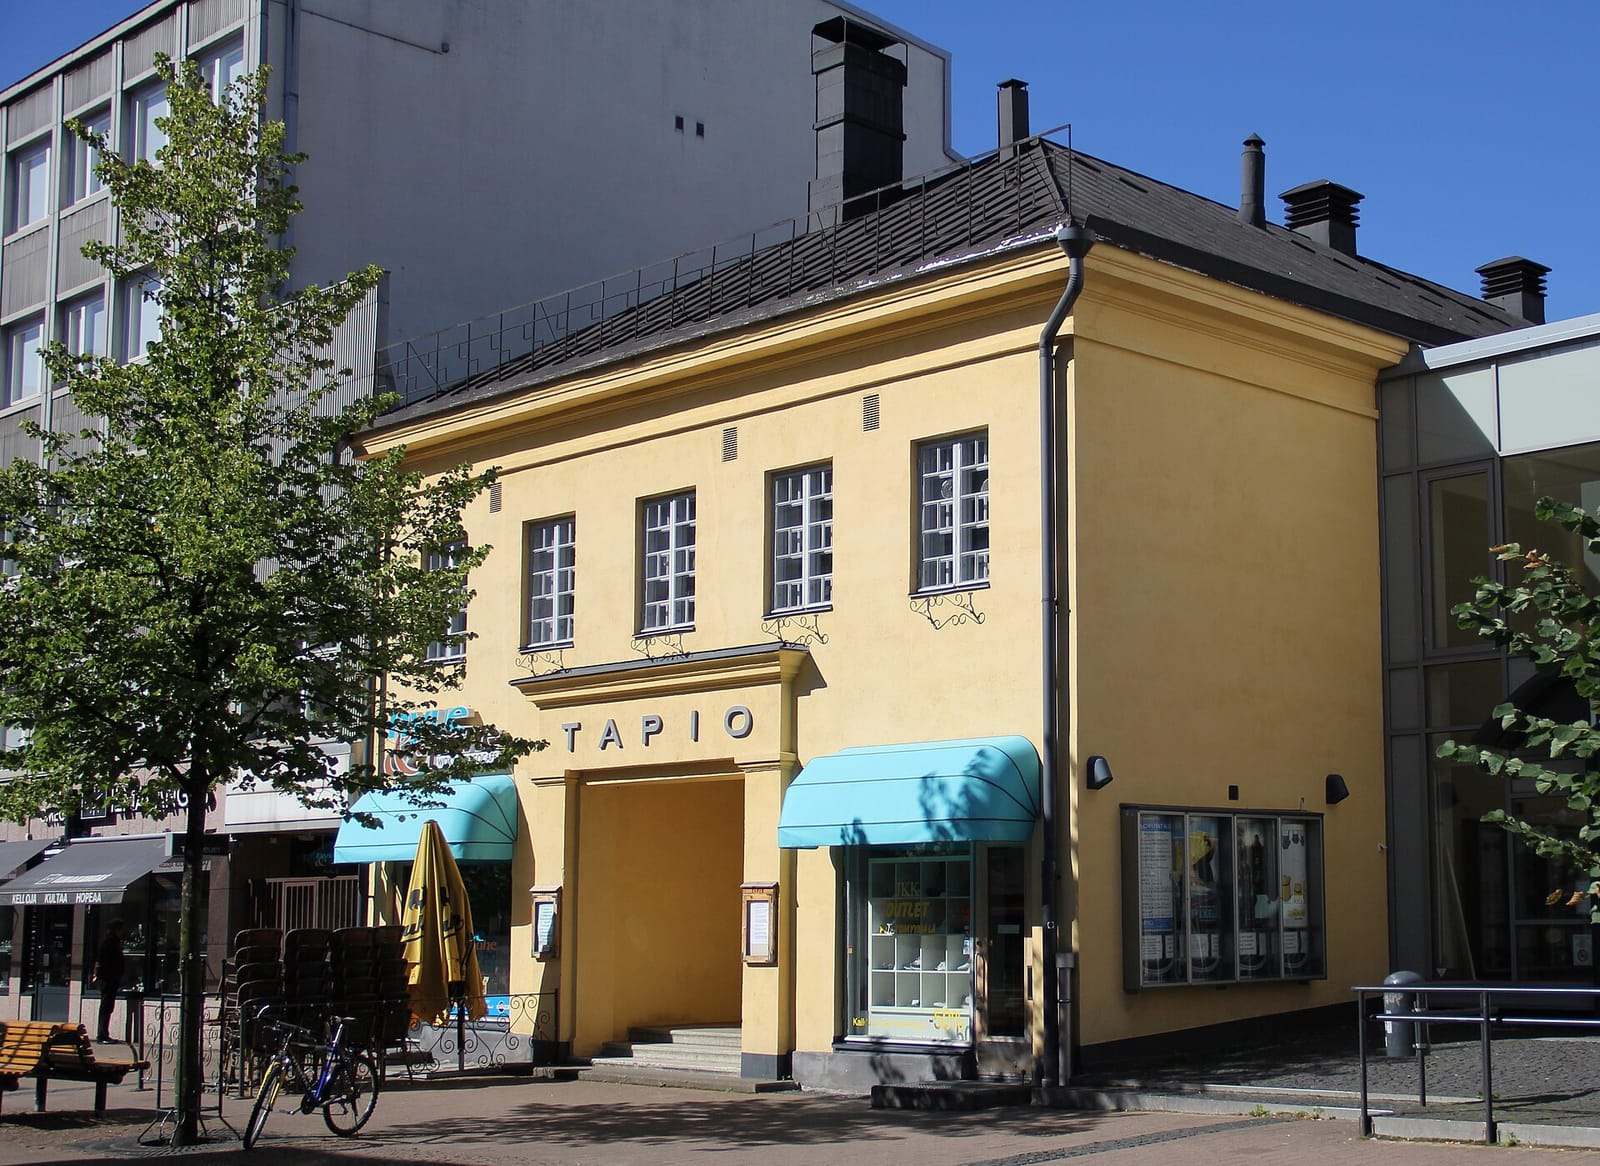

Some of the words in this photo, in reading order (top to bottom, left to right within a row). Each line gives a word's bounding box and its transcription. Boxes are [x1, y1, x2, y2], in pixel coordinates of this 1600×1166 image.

[561, 705, 753, 752] TAPIO
[11, 893, 37, 904] KELLOJA
[44, 893, 68, 904] KULTAA
[75, 892, 102, 903] HOPEAA
[885, 901, 930, 918] OUTLET
